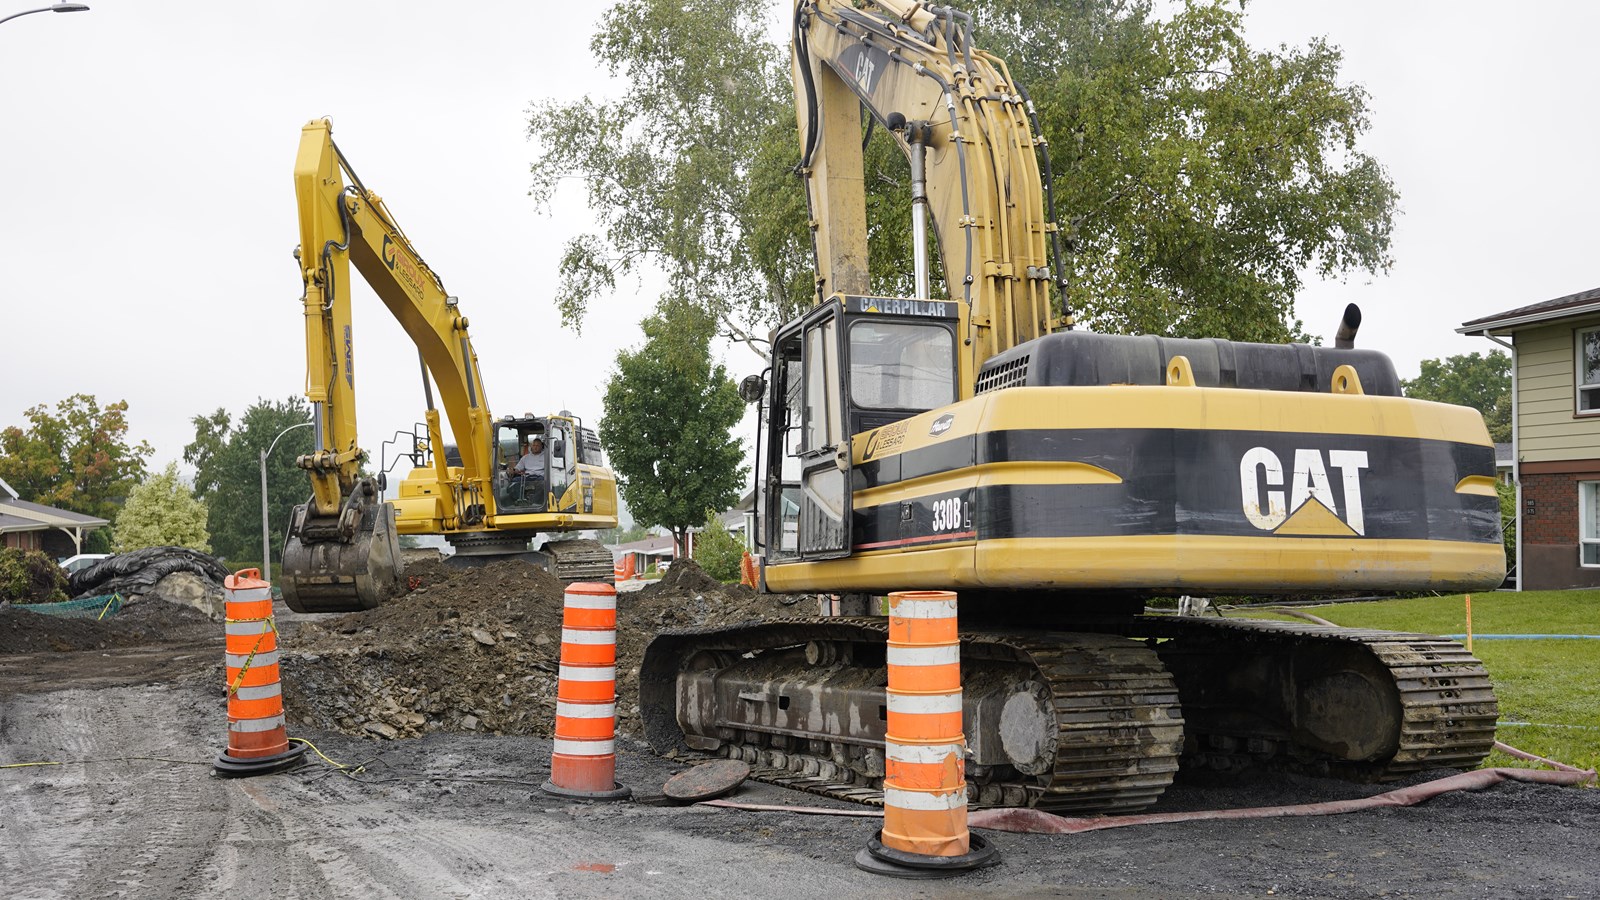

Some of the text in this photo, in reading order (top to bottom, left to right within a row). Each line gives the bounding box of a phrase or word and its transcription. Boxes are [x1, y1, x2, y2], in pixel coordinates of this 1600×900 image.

[855, 51, 875, 94] CAT
[860, 297, 946, 317] CATERPILLAR
[1240, 446, 1369, 536] CAT
[932, 497, 972, 532] 330B L
